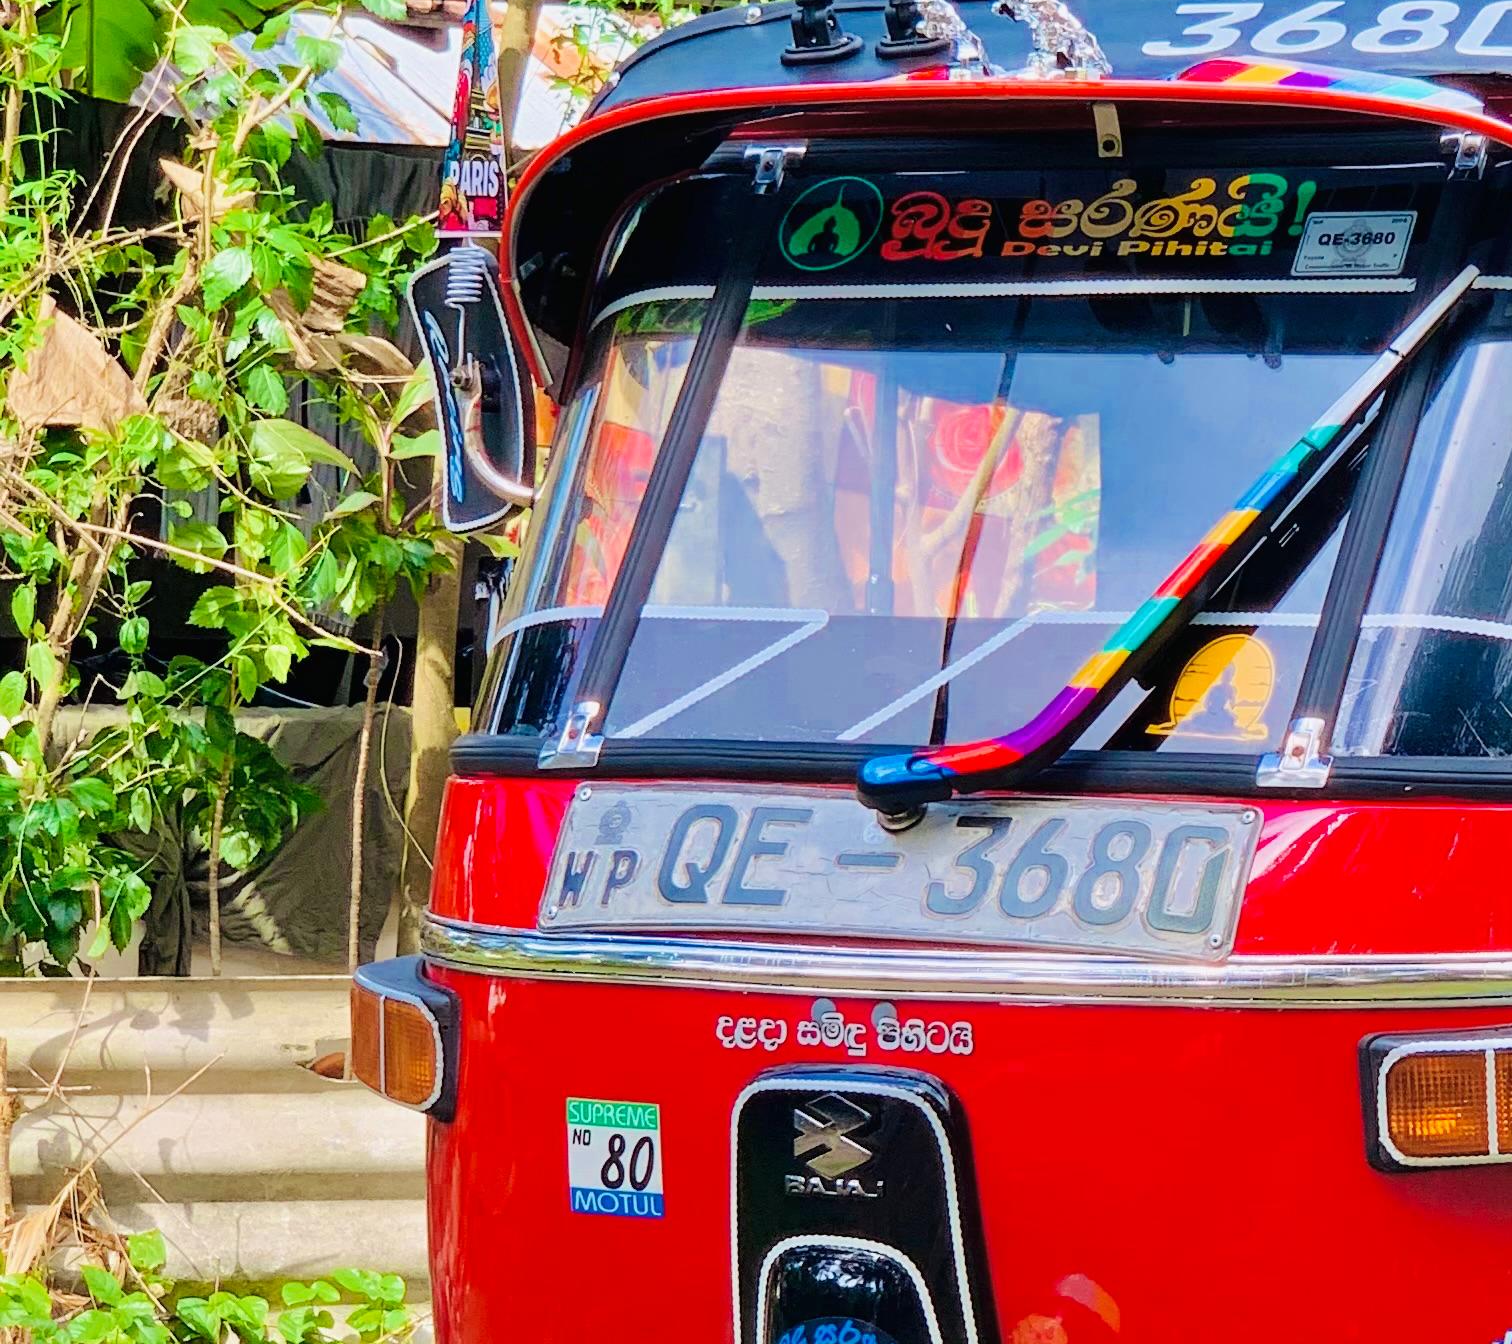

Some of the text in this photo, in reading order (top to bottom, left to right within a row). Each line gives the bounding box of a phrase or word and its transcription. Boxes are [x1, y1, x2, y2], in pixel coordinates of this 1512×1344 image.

[450, 159, 500, 198] PARIS
[1001, 240, 1273, 257] Devi Pihitai
[1317, 231, 1396, 247] QE-3680
[921, 815, 1232, 934] 3680
[715, 1016, 788, 1051] දළදා
[568, 1101, 656, 1128] SUPREME
[600, 1133, 655, 1192] 80
[574, 1190, 662, 1216] MOTUL
